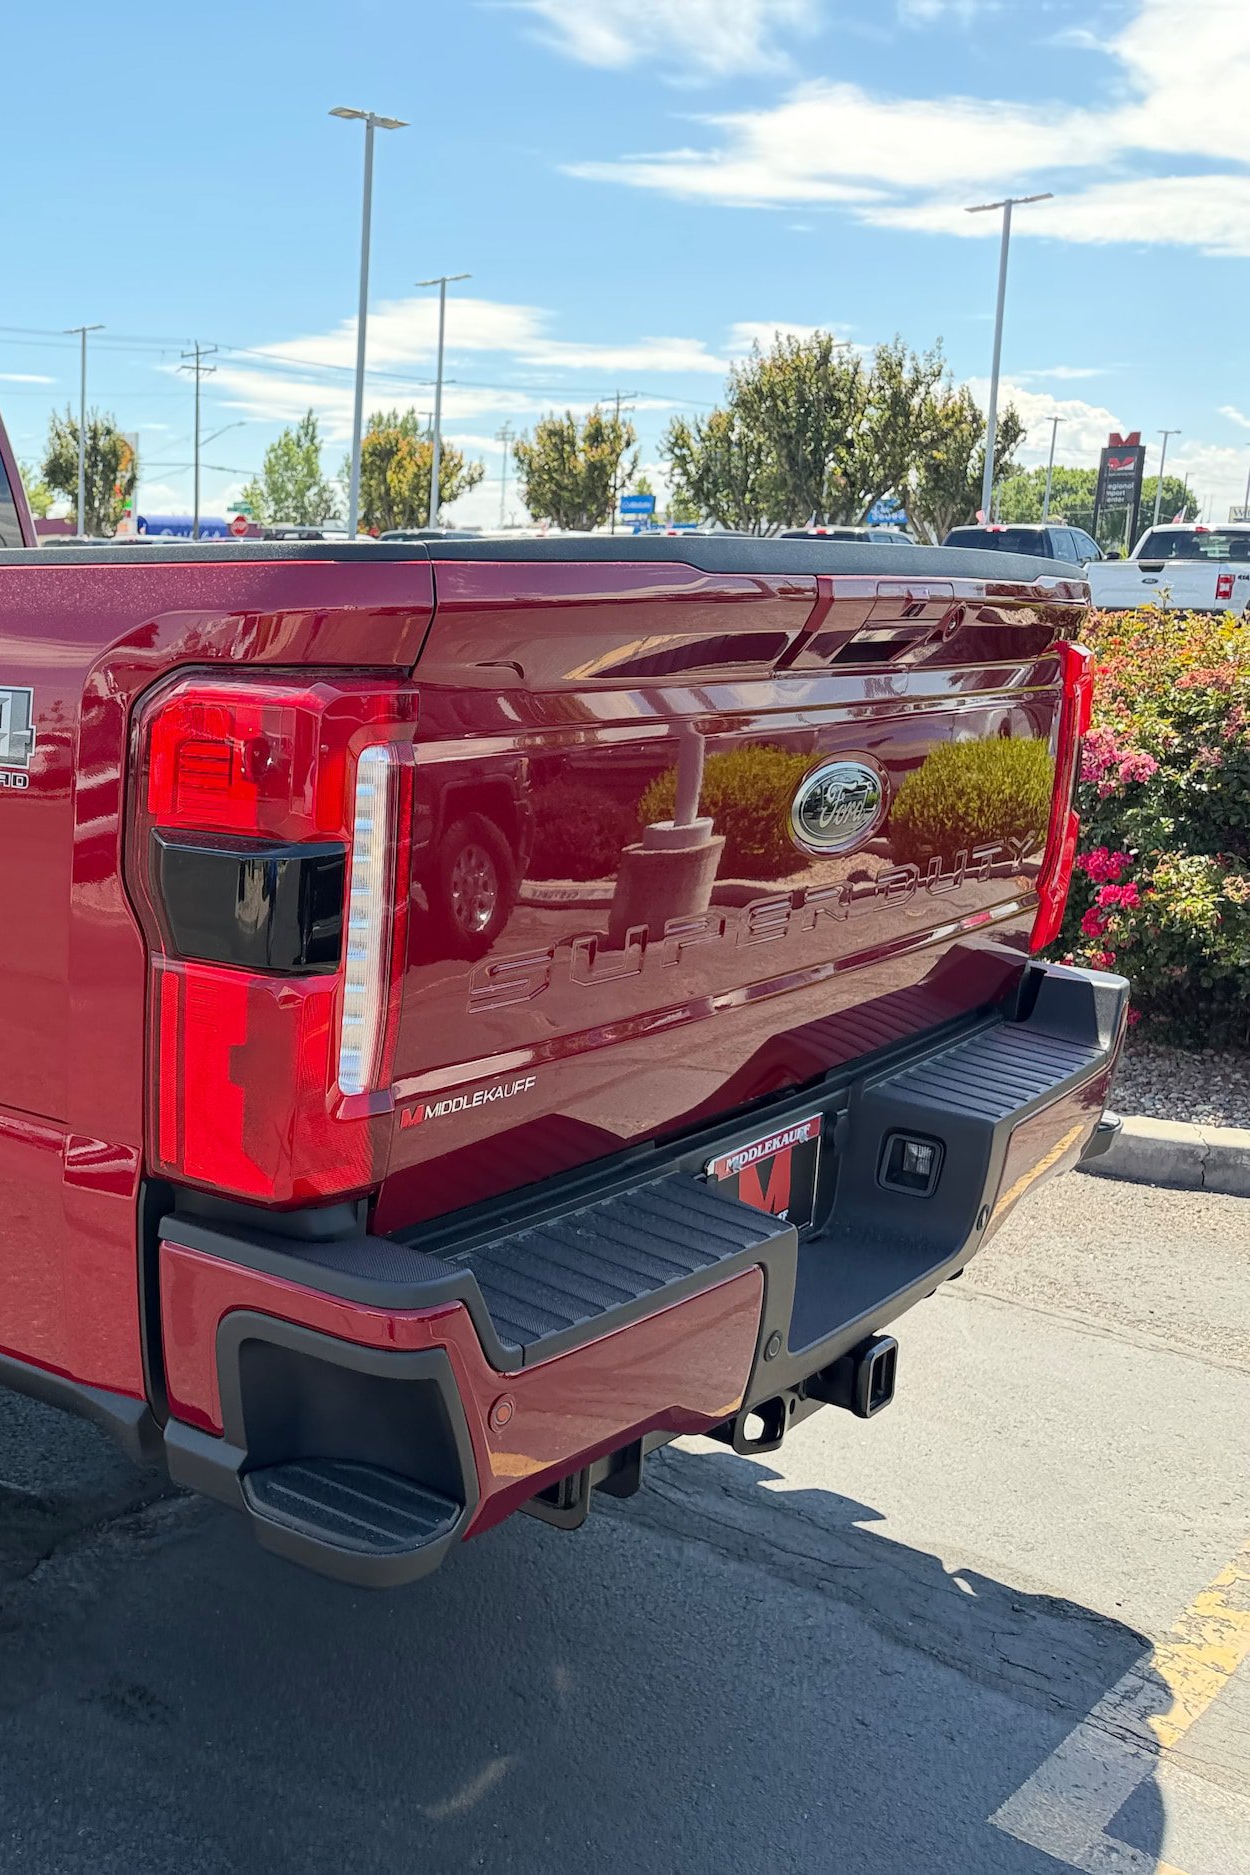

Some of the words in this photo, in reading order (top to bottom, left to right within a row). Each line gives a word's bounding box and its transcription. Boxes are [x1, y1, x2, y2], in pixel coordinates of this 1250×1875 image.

[1107, 482, 1135, 491] egional
[819, 781, 877, 828] Ford
[467, 880, 854, 1014] SUPER
[873, 830, 1036, 912] DUTY
[424, 1076, 536, 1120] MIDDLEKAUFF
[725, 1123, 811, 1172] MDDLEKAUFF
